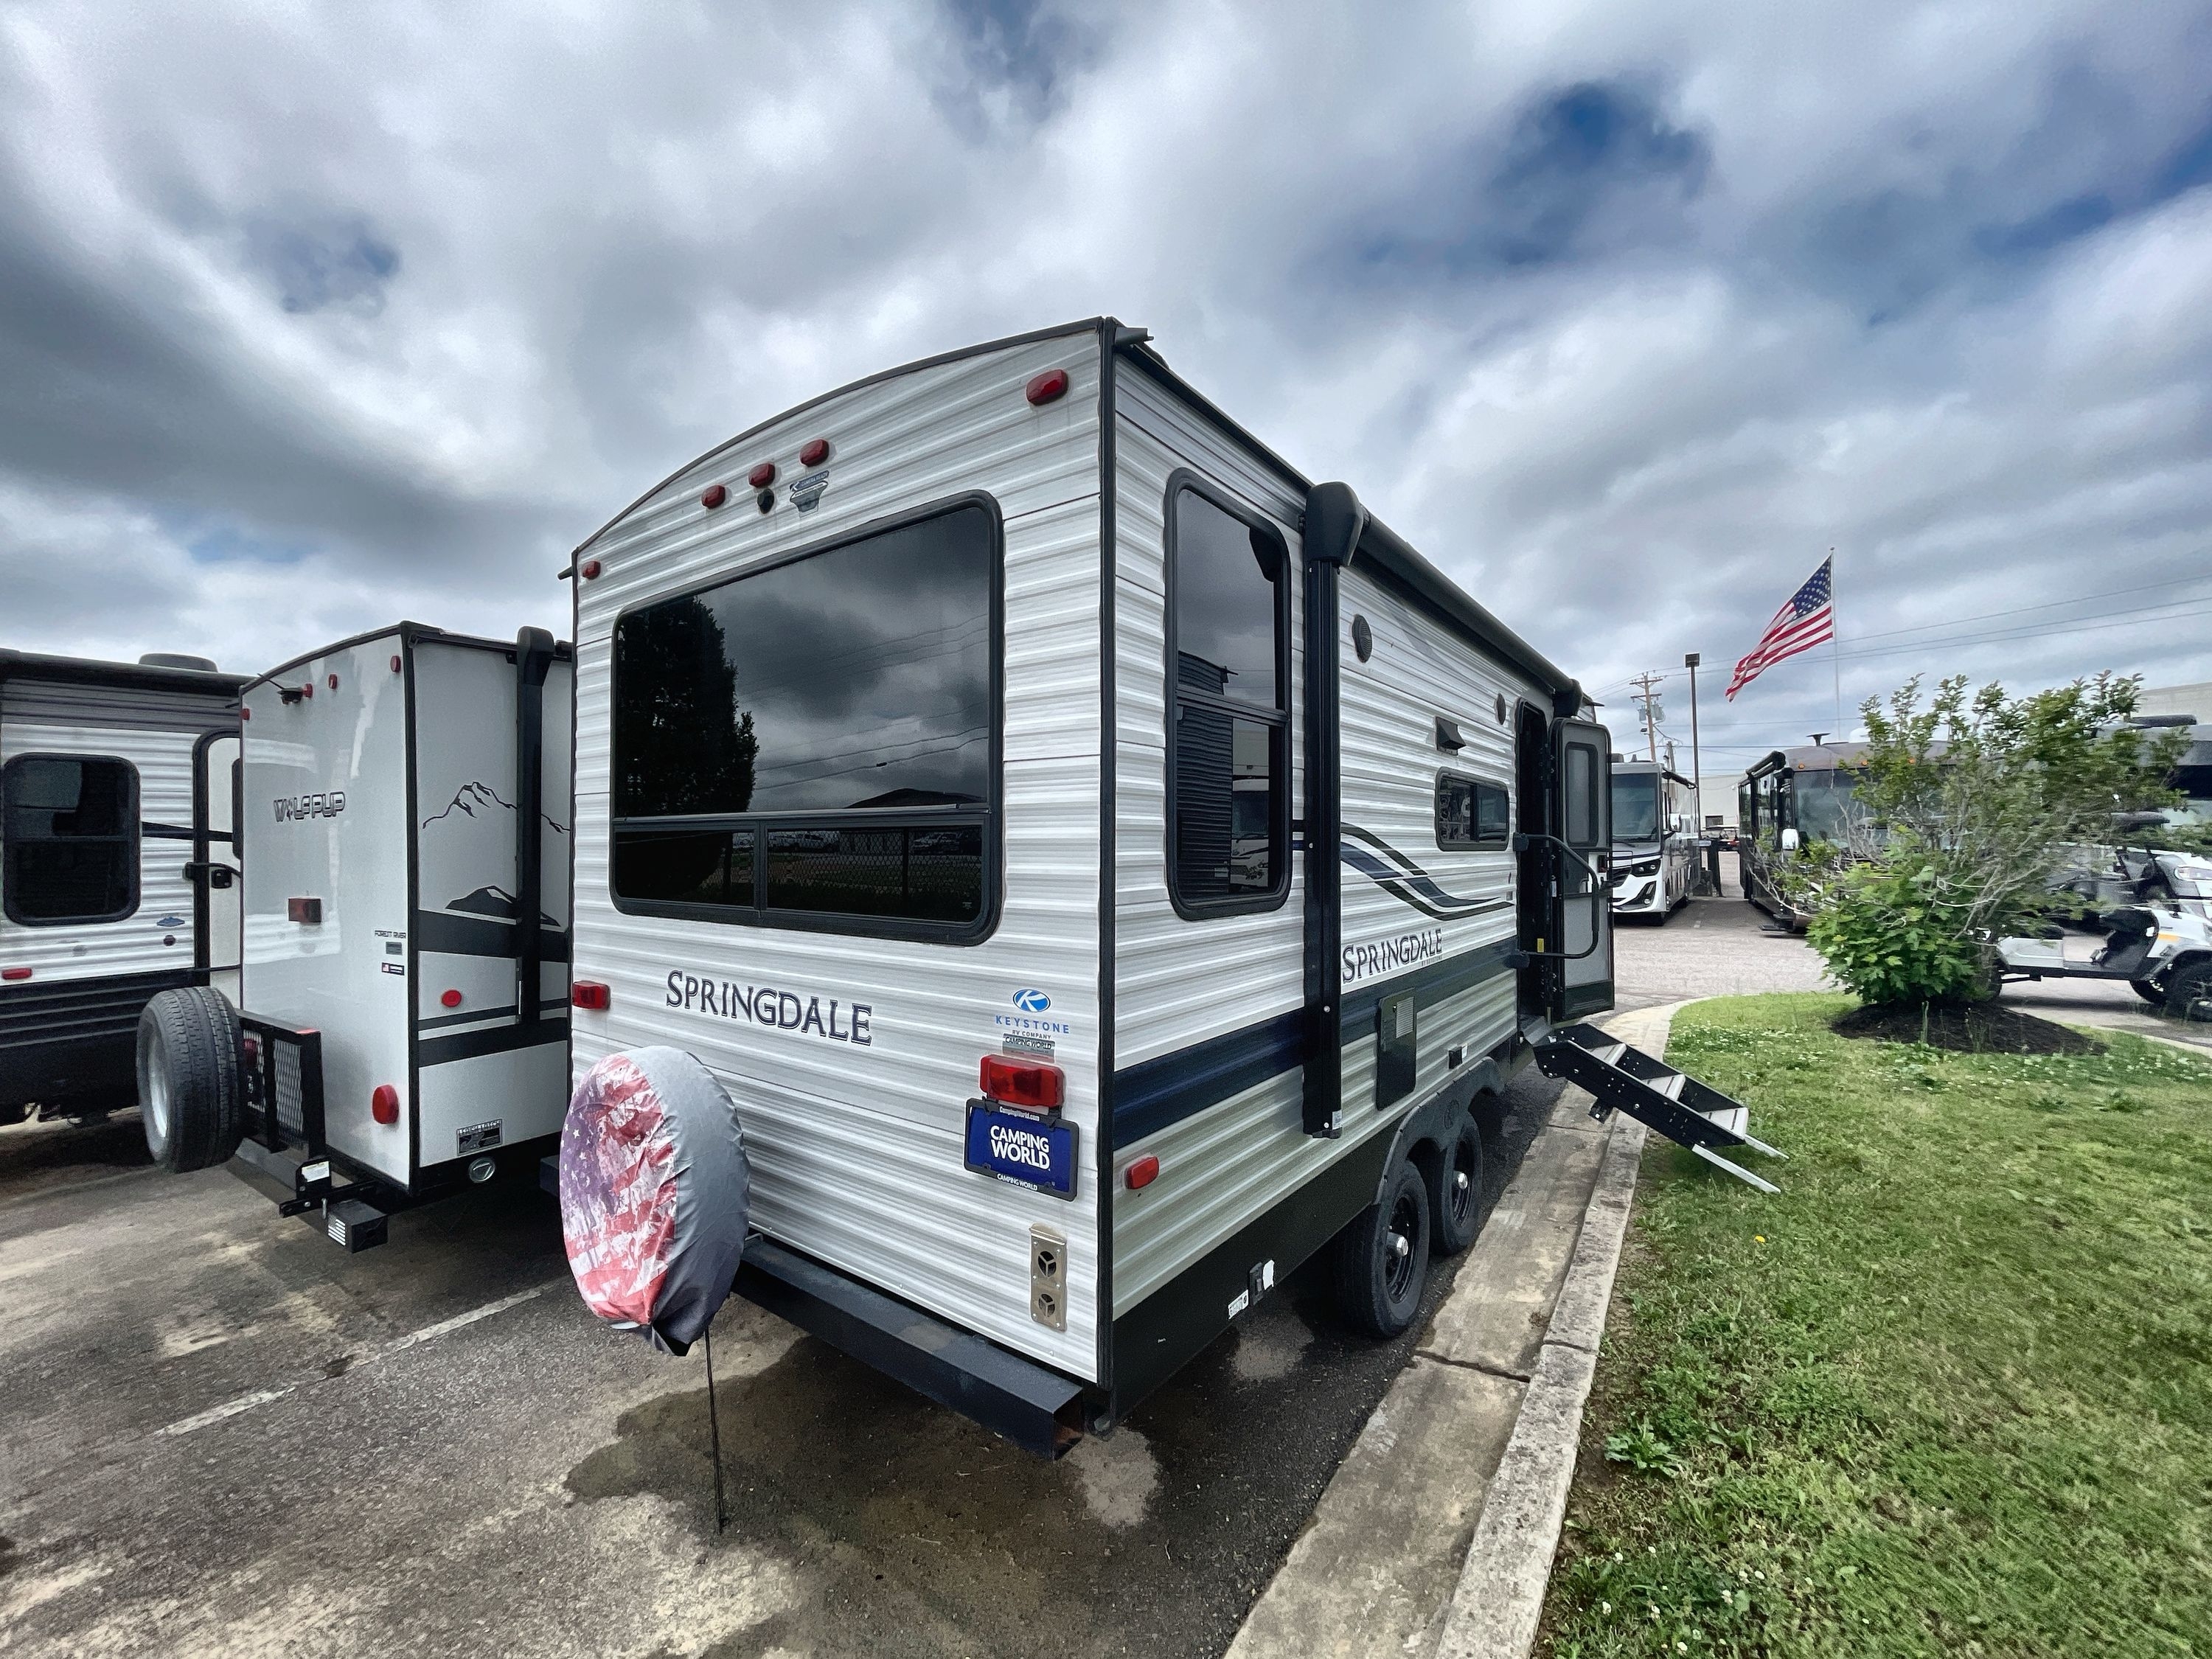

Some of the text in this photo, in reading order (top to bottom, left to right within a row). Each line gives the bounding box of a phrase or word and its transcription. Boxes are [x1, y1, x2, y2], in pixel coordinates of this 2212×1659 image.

[311, 790, 346, 819] PUP
[1342, 927, 1443, 984] SPRINGDALE
[666, 969, 873, 1047] SPRINGDALE
[995, 1015, 1070, 1034] KEYSTONE
[1021, 1031, 1051, 1040] COMPANY
[1005, 1036, 1052, 1050] CAMPING WORLD
[990, 1125, 1049, 1153] CAMPING
[990, 1139, 1051, 1170] WORLD
[997, 1173, 1038, 1192] CAMPING WORLD
